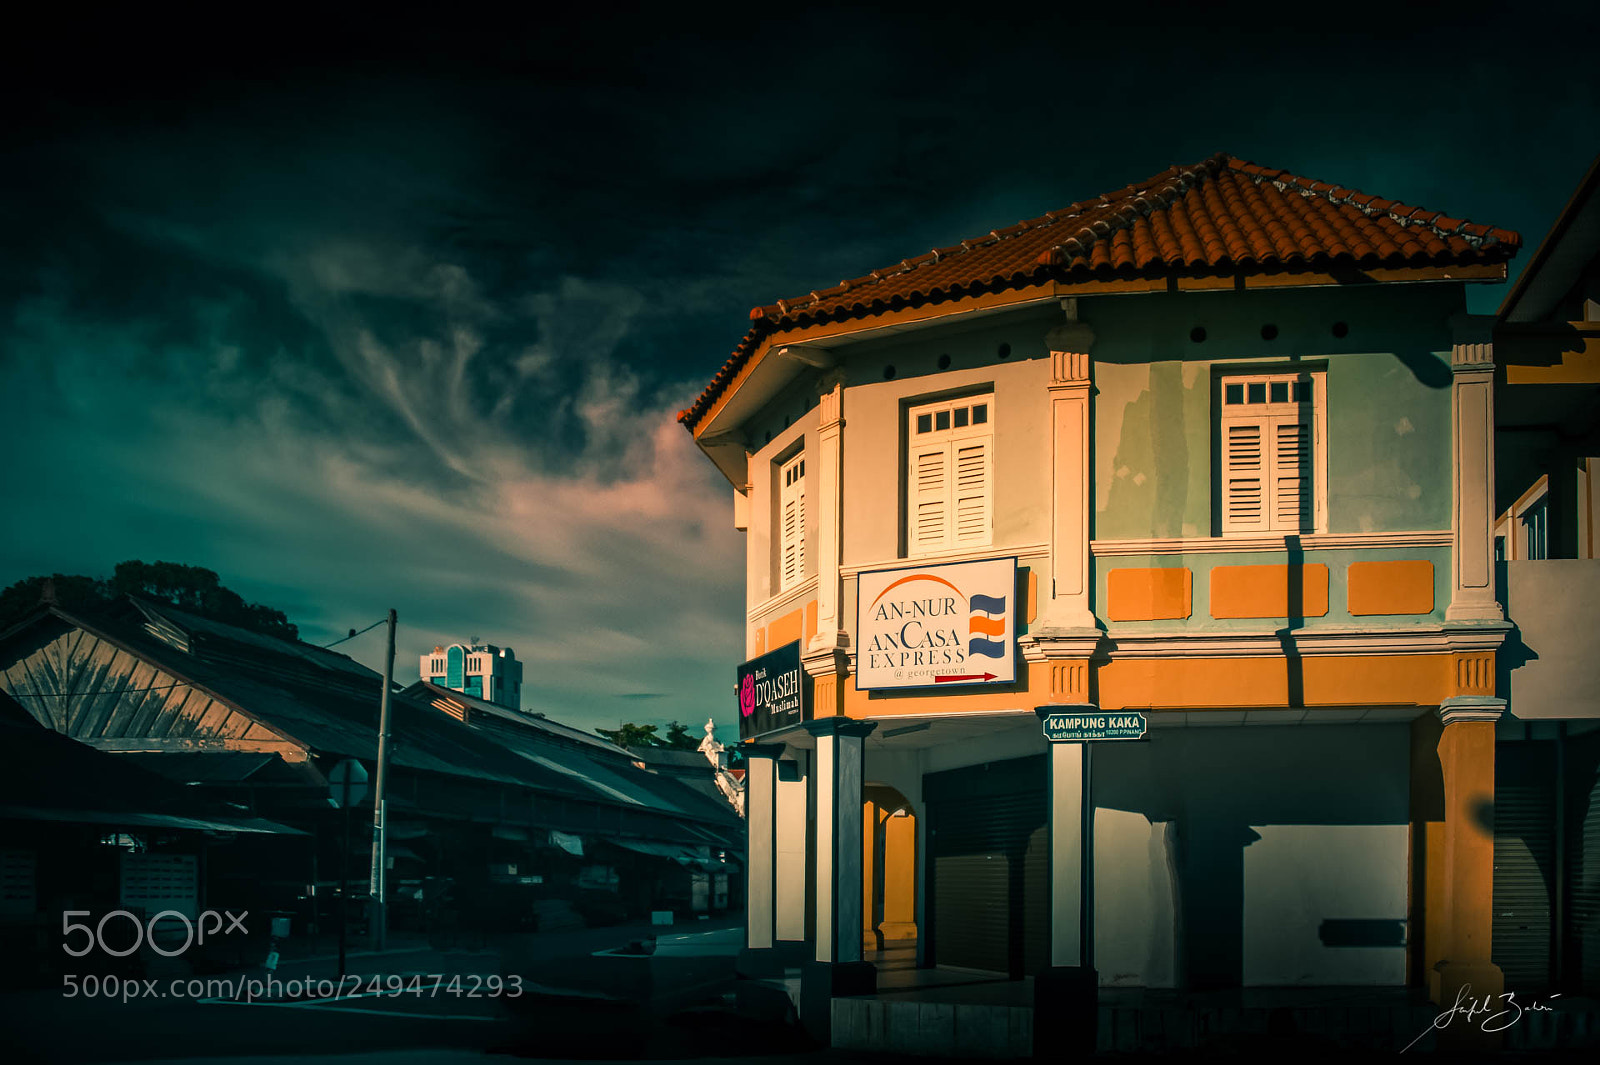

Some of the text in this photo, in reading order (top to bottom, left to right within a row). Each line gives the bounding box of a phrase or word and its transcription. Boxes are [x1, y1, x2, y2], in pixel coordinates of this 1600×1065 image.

[875, 597, 957, 621] AN-NUR
[870, 648, 965, 669] EXPRESS
[893, 667, 967, 680] @ georgetown
[771, 696, 799, 715] Muslimah
[1049, 717, 1140, 730] KAMPUNG KAKA
